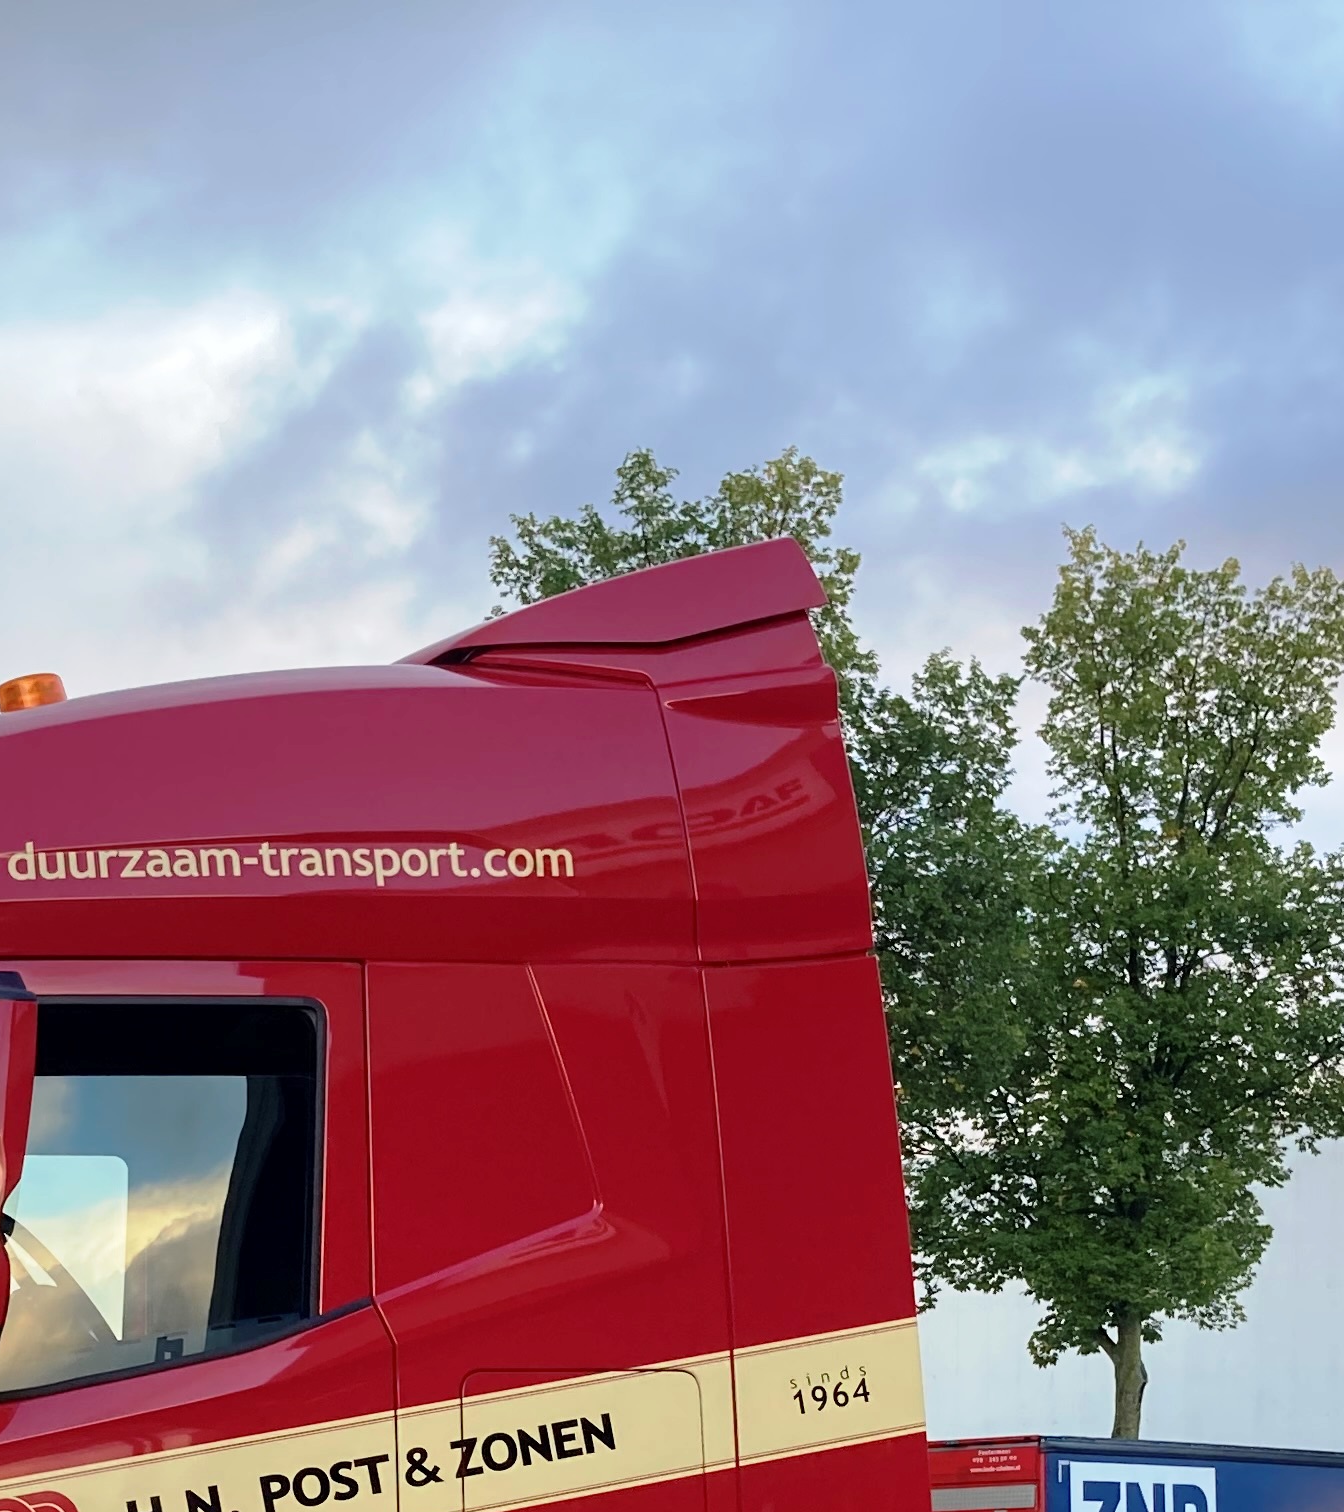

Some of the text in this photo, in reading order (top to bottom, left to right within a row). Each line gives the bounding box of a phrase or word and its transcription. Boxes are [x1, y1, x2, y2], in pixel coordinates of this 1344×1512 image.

[8, 841, 574, 886] duurzaam-transport.com
[789, 1364, 867, 1389] sinds
[793, 1377, 870, 1415] 1964
[405, 1446, 444, 1487] &
[449, 1412, 616, 1479] ZONEN
